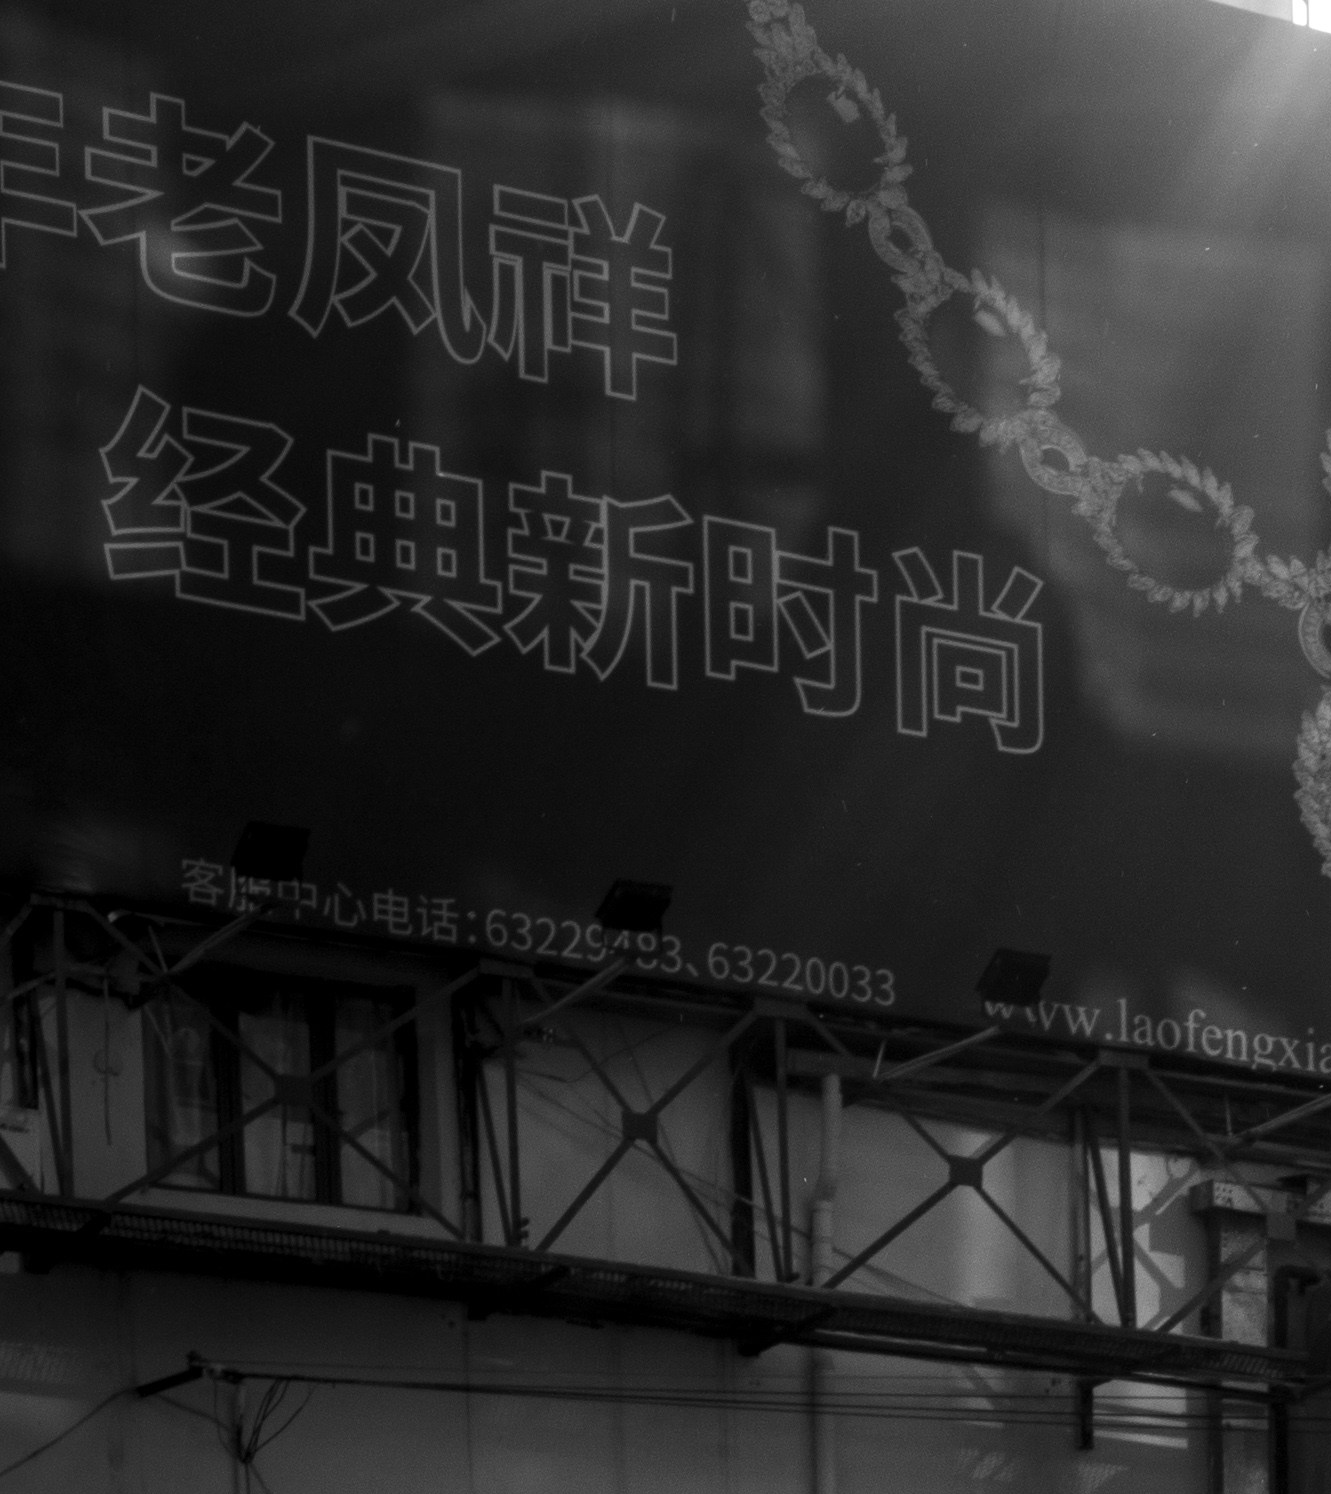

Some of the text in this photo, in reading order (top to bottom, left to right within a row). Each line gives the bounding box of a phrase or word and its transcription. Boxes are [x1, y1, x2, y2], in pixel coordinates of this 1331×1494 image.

[100, 384, 1045, 754] 经典新时尚
